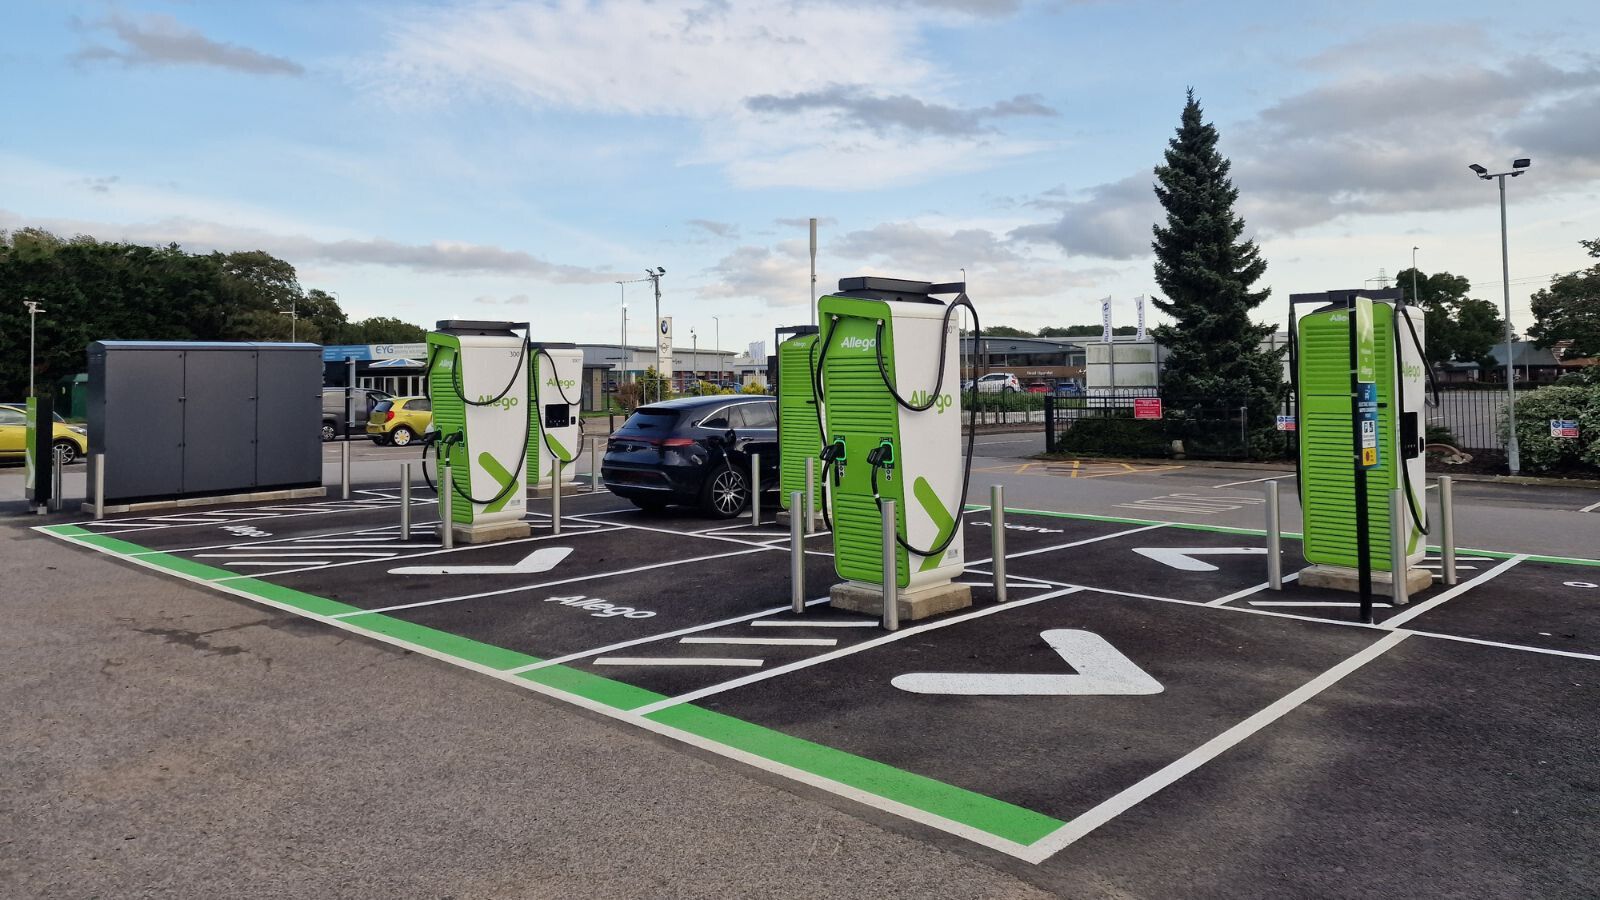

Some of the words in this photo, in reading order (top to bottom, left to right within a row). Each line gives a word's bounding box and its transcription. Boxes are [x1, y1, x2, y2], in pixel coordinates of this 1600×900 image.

[1329, 314, 1348, 322] Alle
[375, 345, 394, 354] EYG
[840, 336, 877, 351] Allego
[546, 377, 576, 389] Allego
[476, 394, 519, 411] Allego
[908, 389, 953, 414] Allego
[543, 595, 657, 619] Allego
